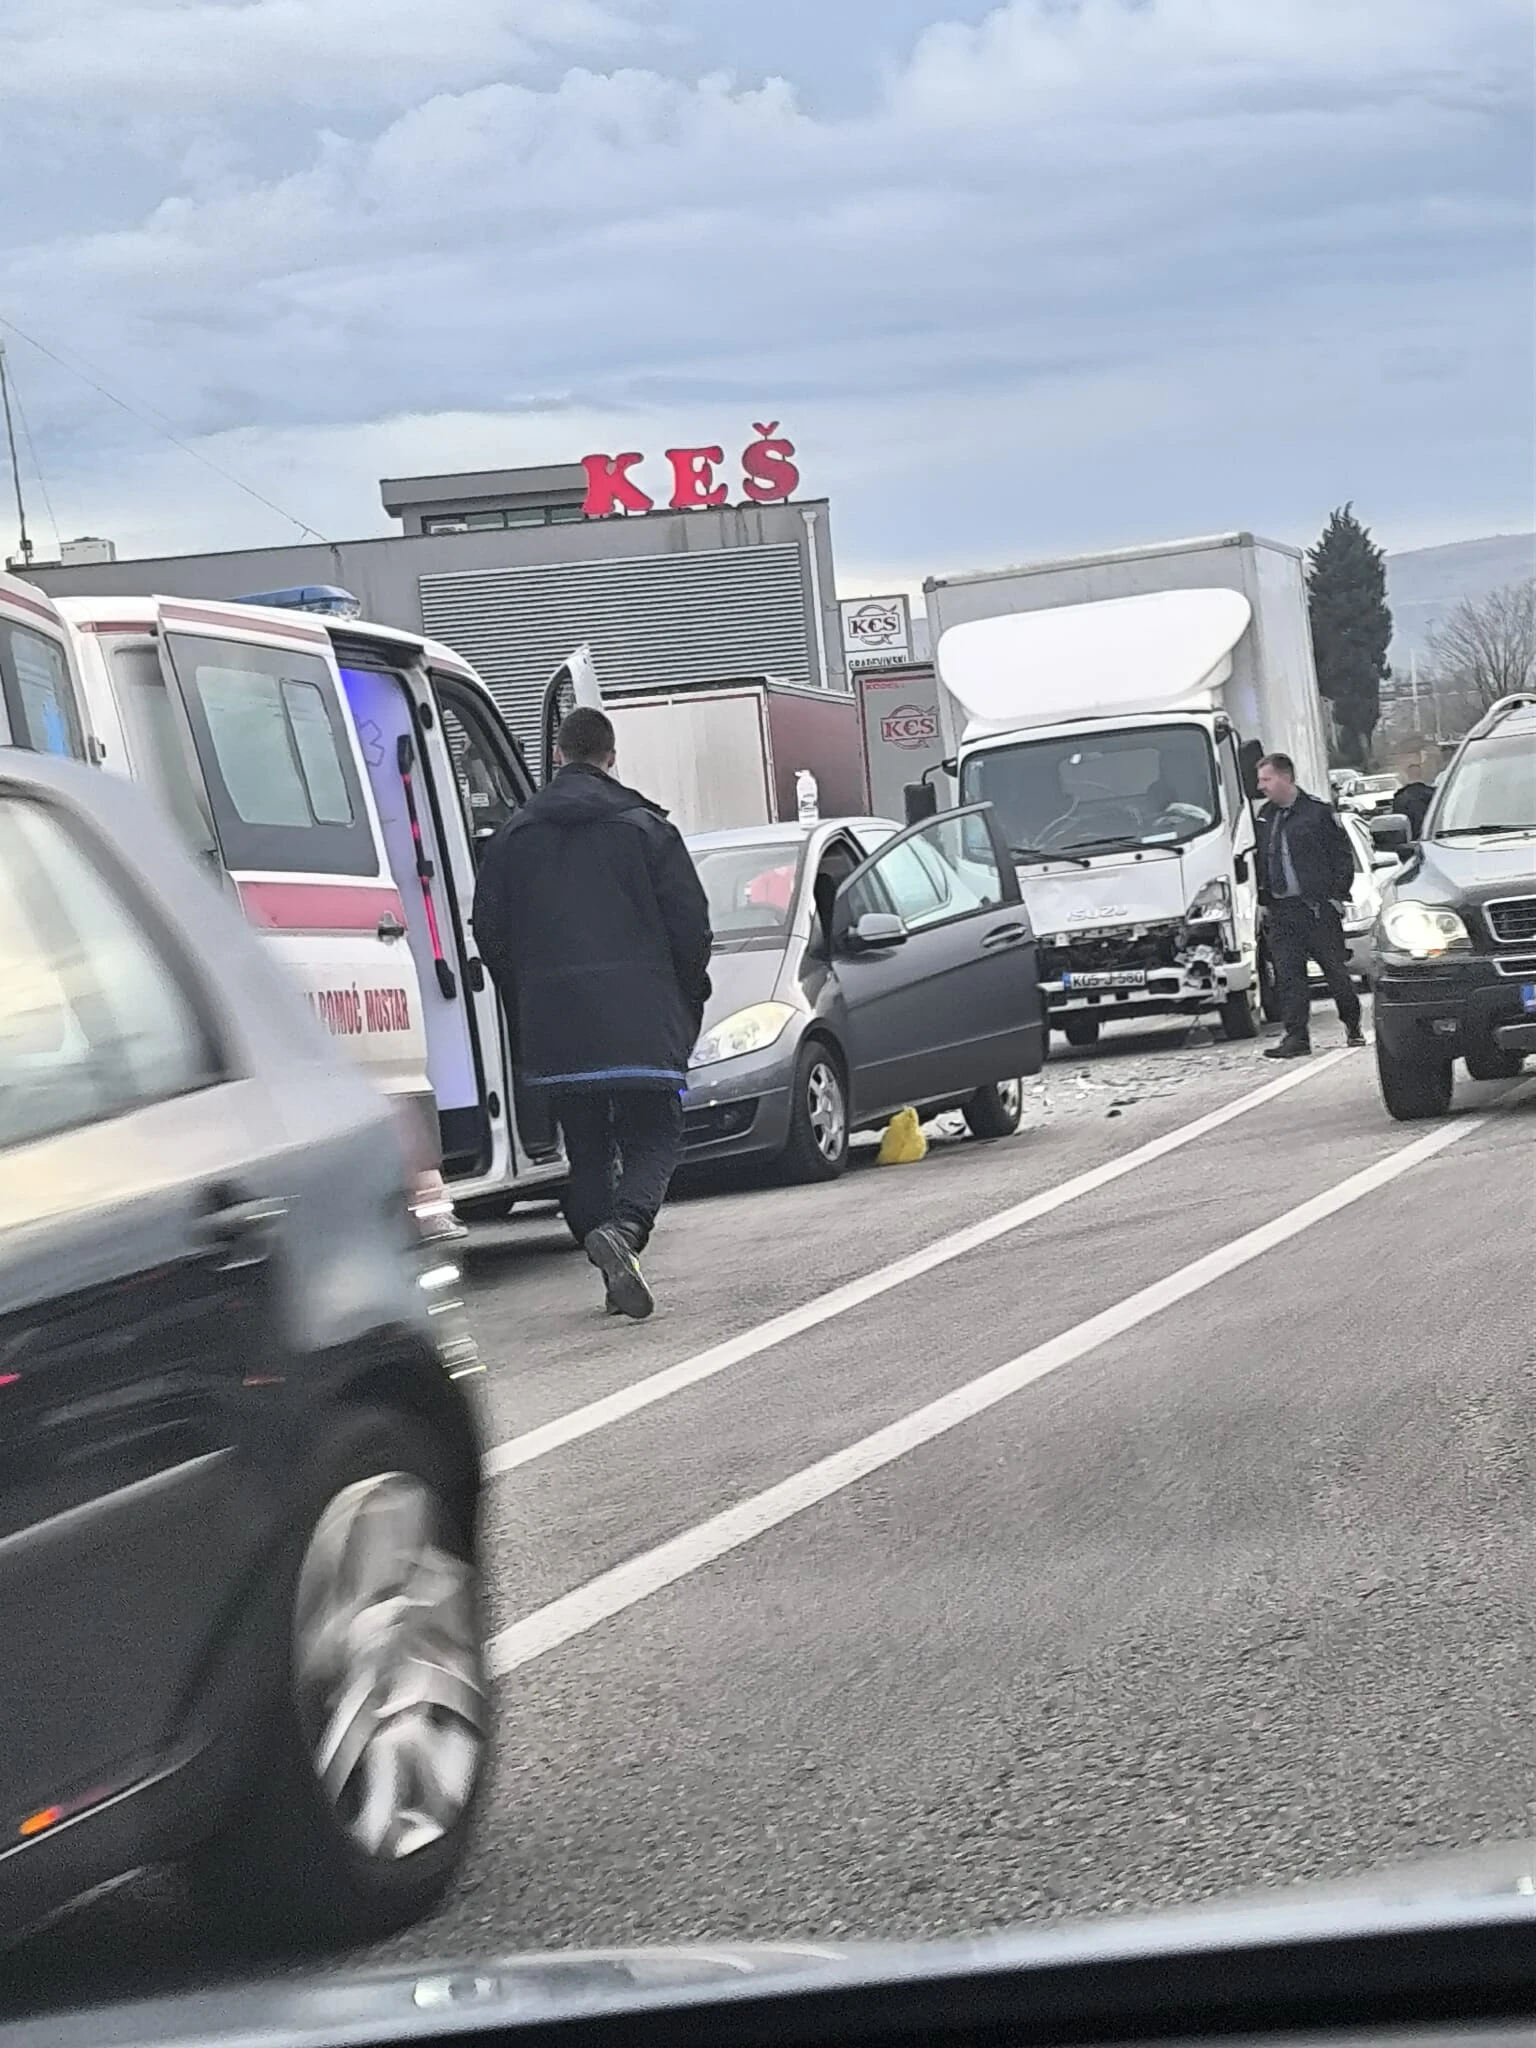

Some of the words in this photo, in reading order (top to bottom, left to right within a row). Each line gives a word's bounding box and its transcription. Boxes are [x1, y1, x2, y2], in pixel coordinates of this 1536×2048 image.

[581, 421, 799, 516] KEŠ
[1067, 905, 1128, 921] ISUZU
[364, 988, 411, 1033] MOSTAR
